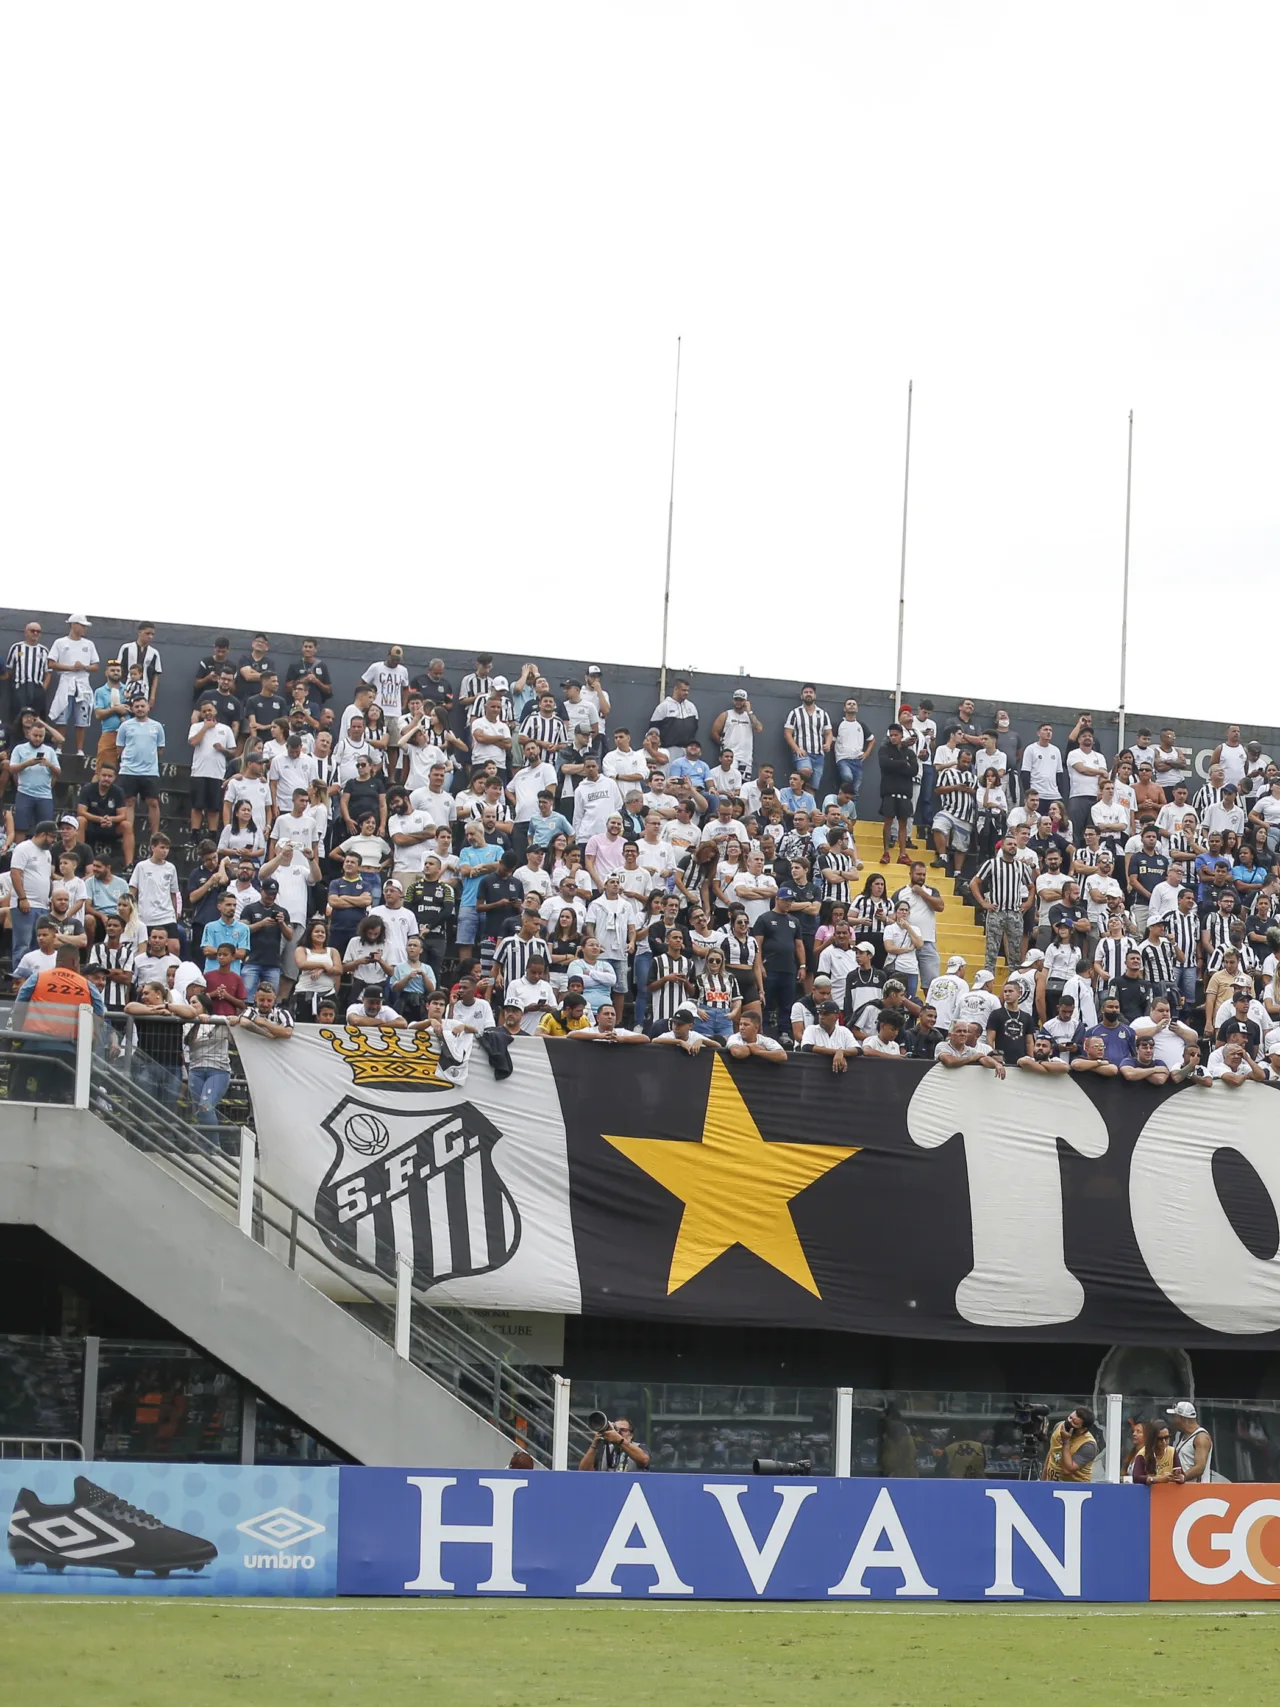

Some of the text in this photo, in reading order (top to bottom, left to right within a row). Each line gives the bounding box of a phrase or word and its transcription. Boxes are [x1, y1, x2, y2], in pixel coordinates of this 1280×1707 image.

[161, 762, 177, 777] 78
[47, 984, 85, 997] 222
[336, 1117, 481, 1224] S.F.C.
[403, 1476, 1092, 1597] HAVAN
[243, 1550, 316, 1570] umbro
